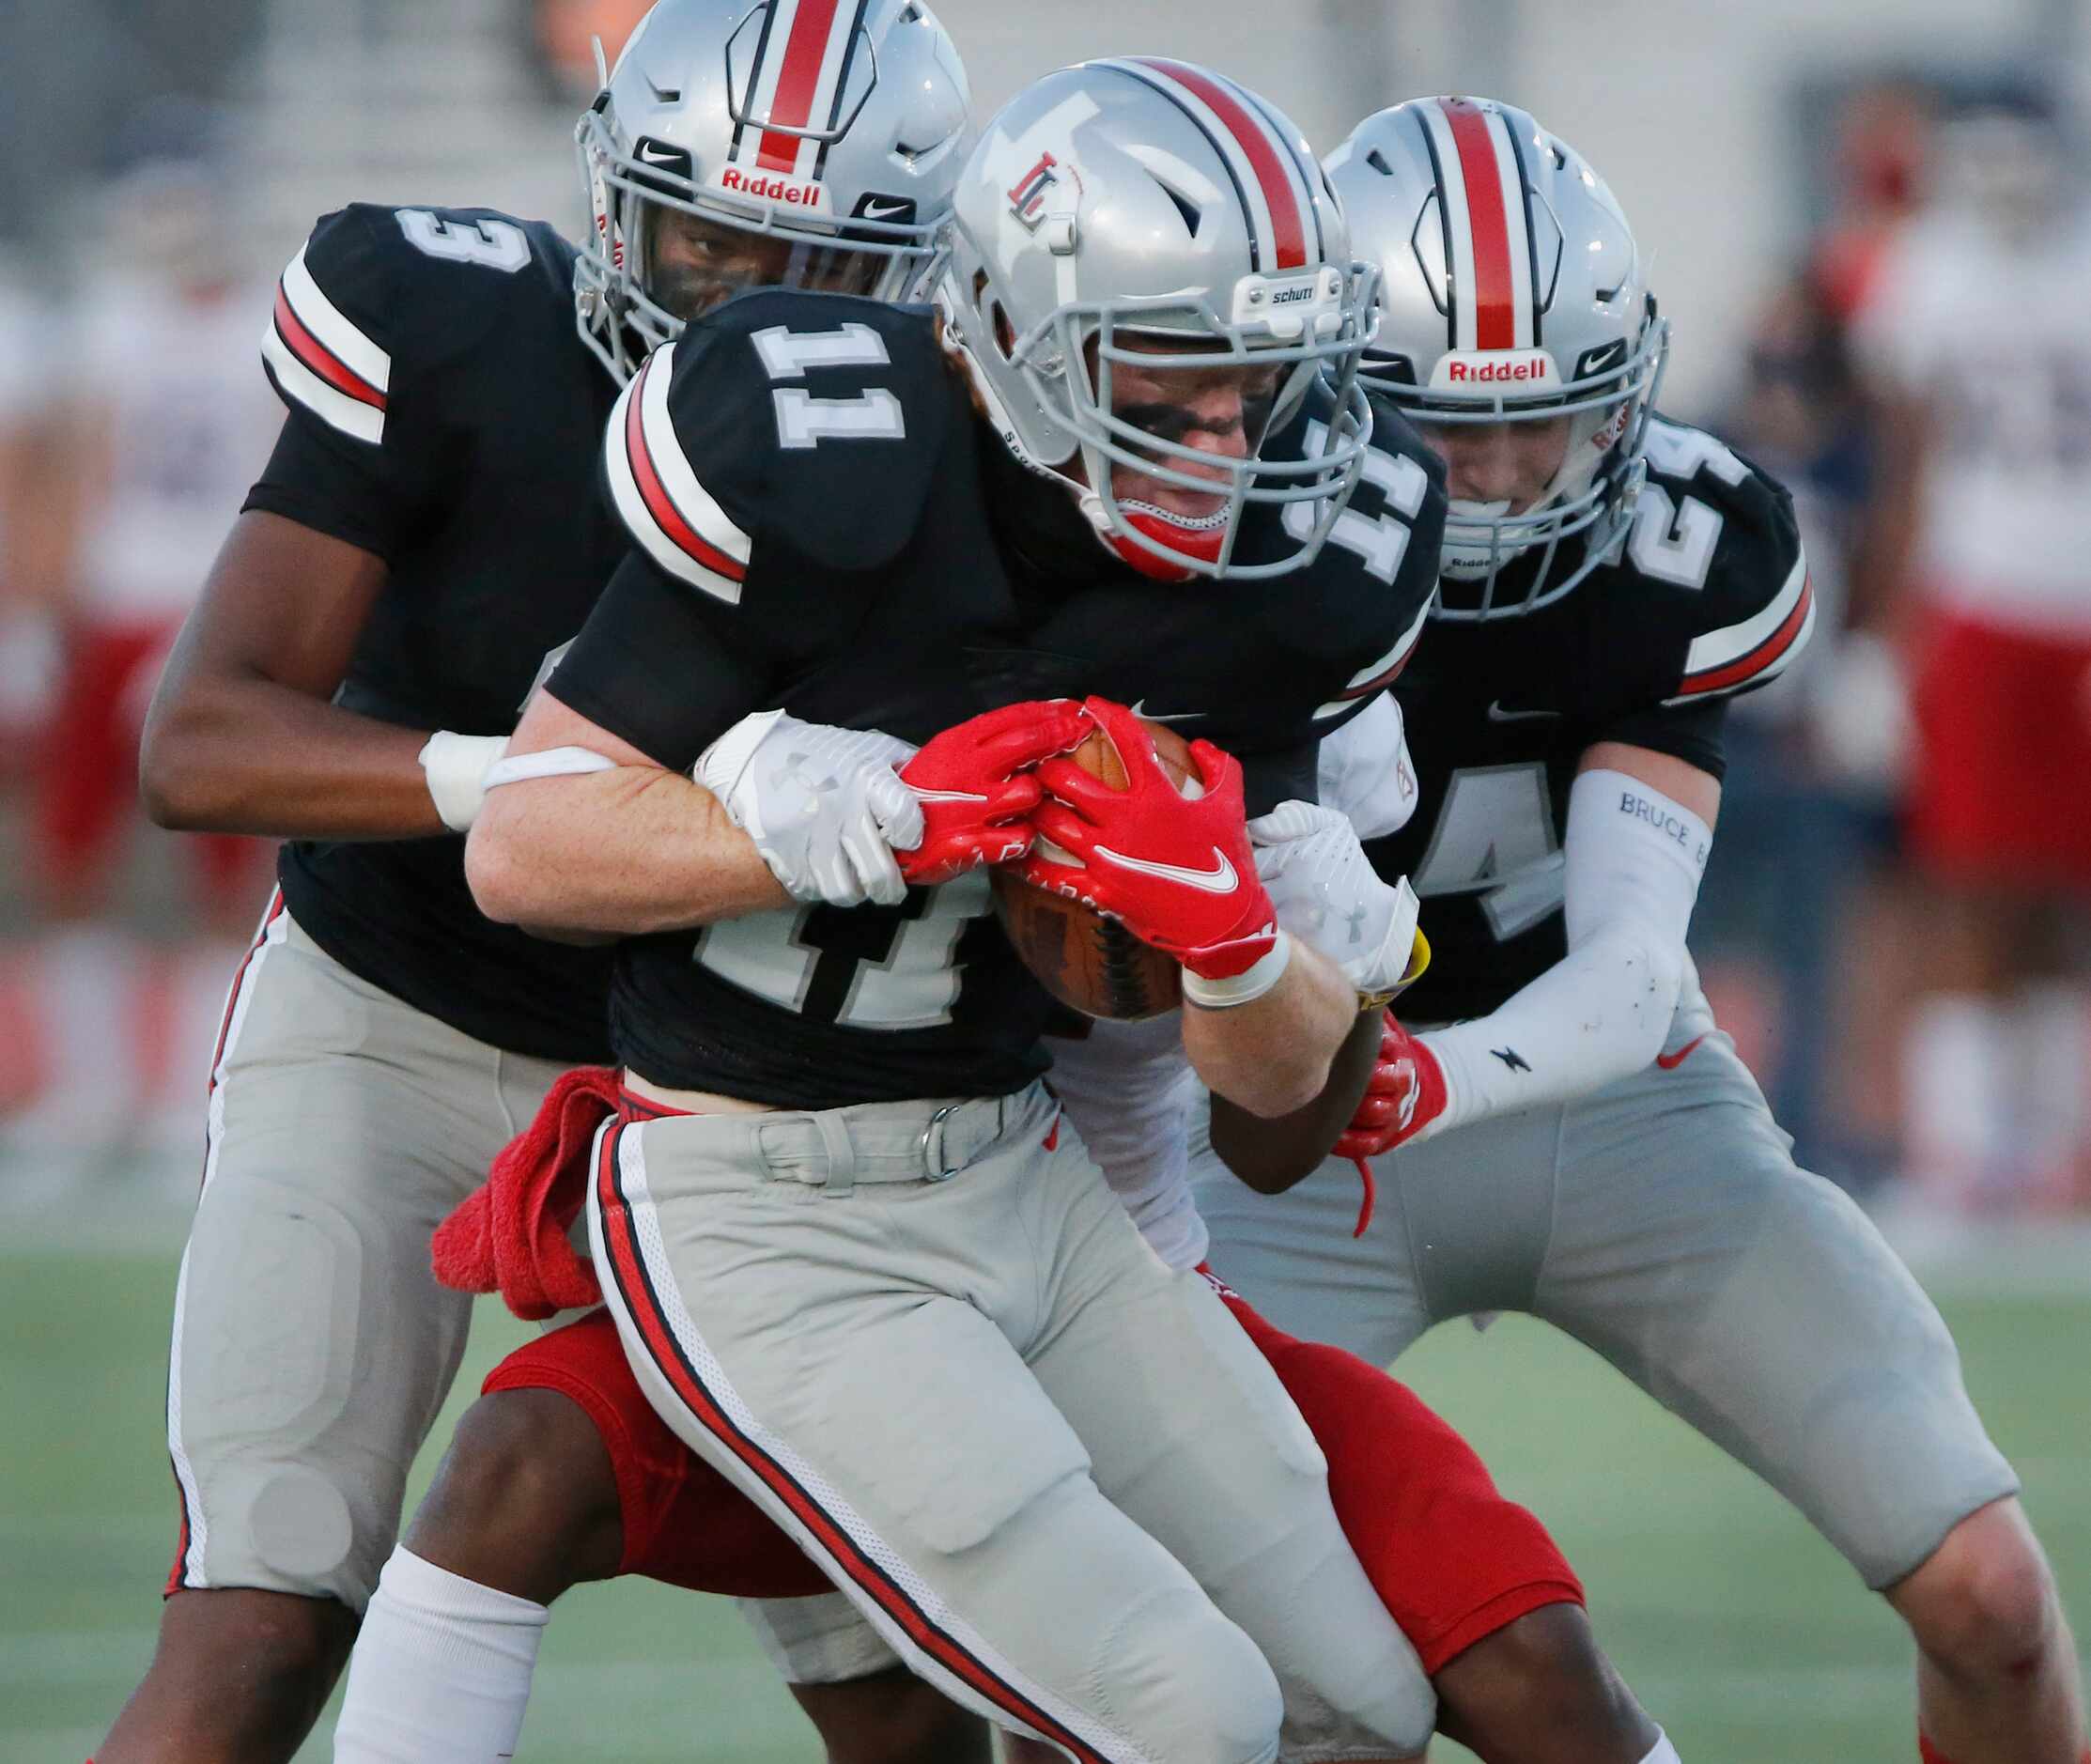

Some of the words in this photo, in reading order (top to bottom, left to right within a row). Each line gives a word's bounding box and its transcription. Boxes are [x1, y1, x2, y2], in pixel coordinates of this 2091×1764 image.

[721, 167, 820, 207] Riddell
[393, 209, 533, 273] 3
[1272, 286, 1313, 303] schutt
[751, 322, 906, 448] 11
[1448, 358, 1546, 382] Riddell
[1619, 792, 1690, 846] BRUCE
